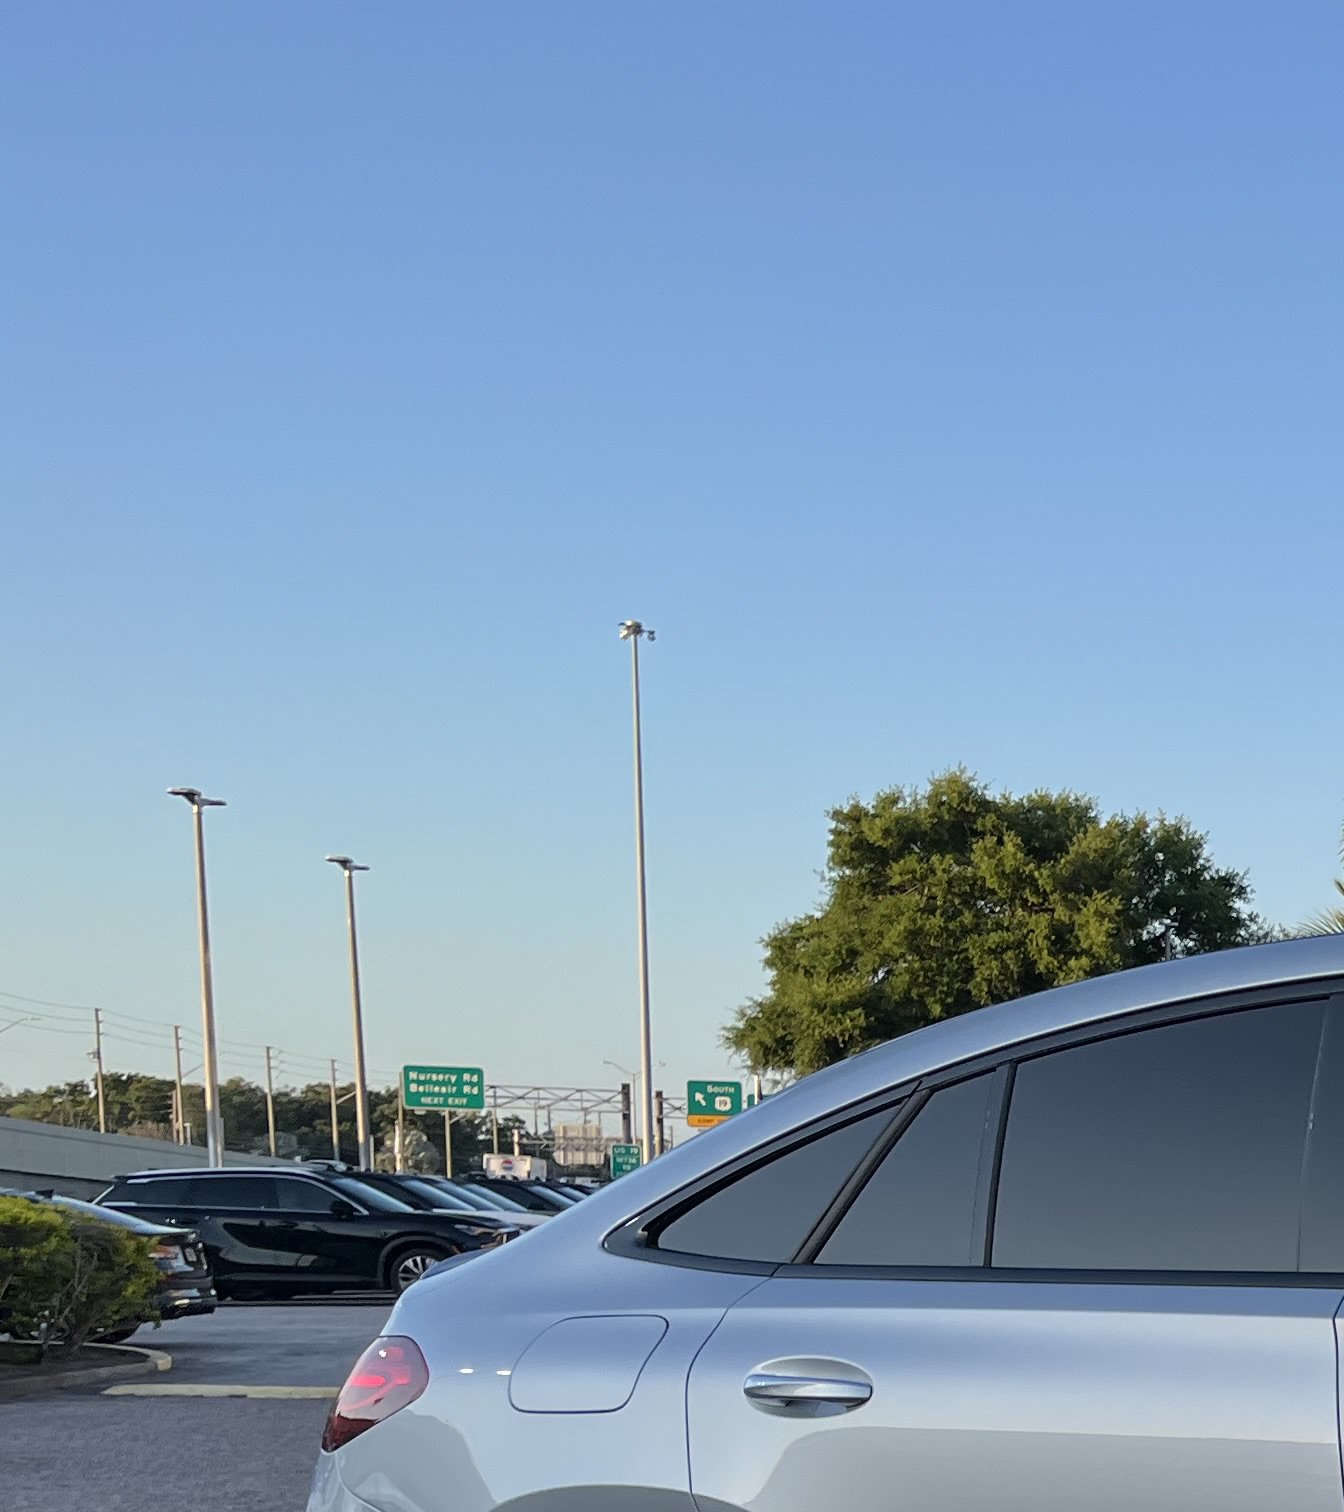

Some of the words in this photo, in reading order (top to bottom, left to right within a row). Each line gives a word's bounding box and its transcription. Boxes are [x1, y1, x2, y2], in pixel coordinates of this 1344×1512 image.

[408, 1071, 457, 1084] Nursery
[463, 1073, 478, 1083] Rd
[409, 1083, 457, 1094] Belleair
[463, 1085, 479, 1095] Rd
